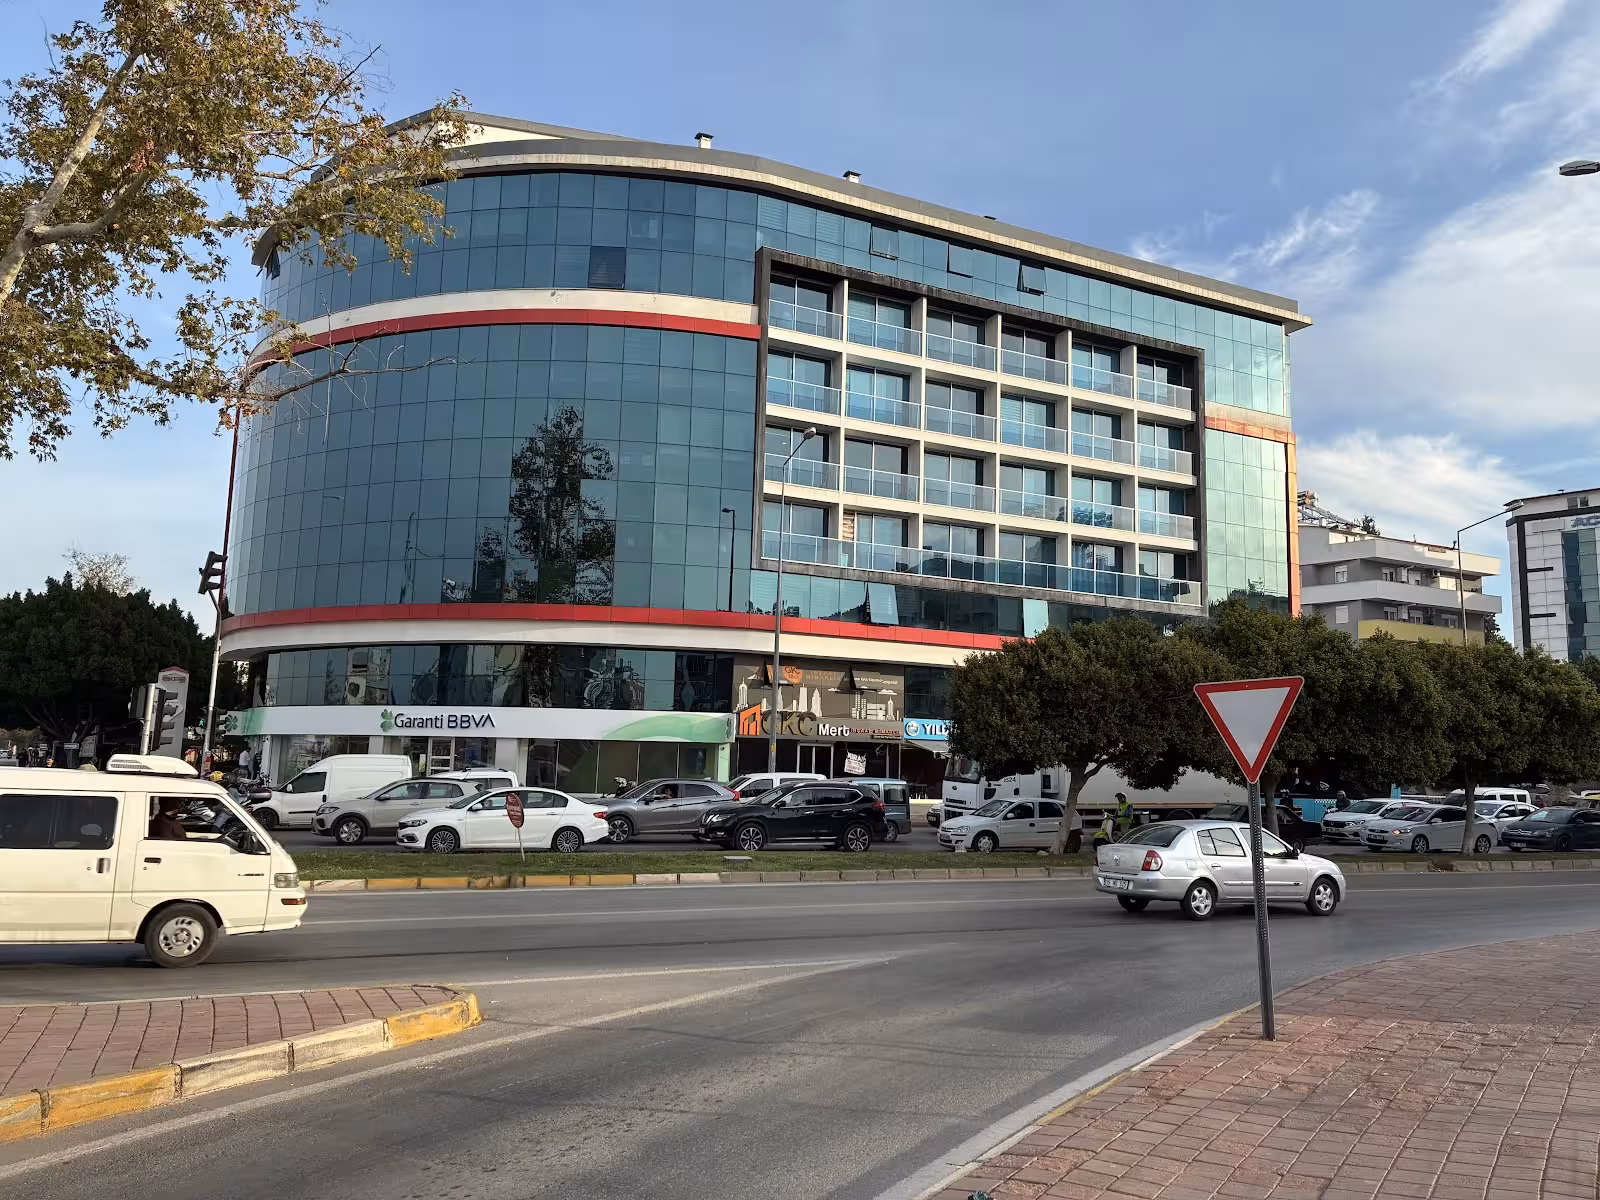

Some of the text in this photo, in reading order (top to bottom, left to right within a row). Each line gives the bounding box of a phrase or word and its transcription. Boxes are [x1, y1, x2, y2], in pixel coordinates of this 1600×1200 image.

[394, 713, 496, 729] Garanti BBVA
[818, 723, 850, 737] Mert
